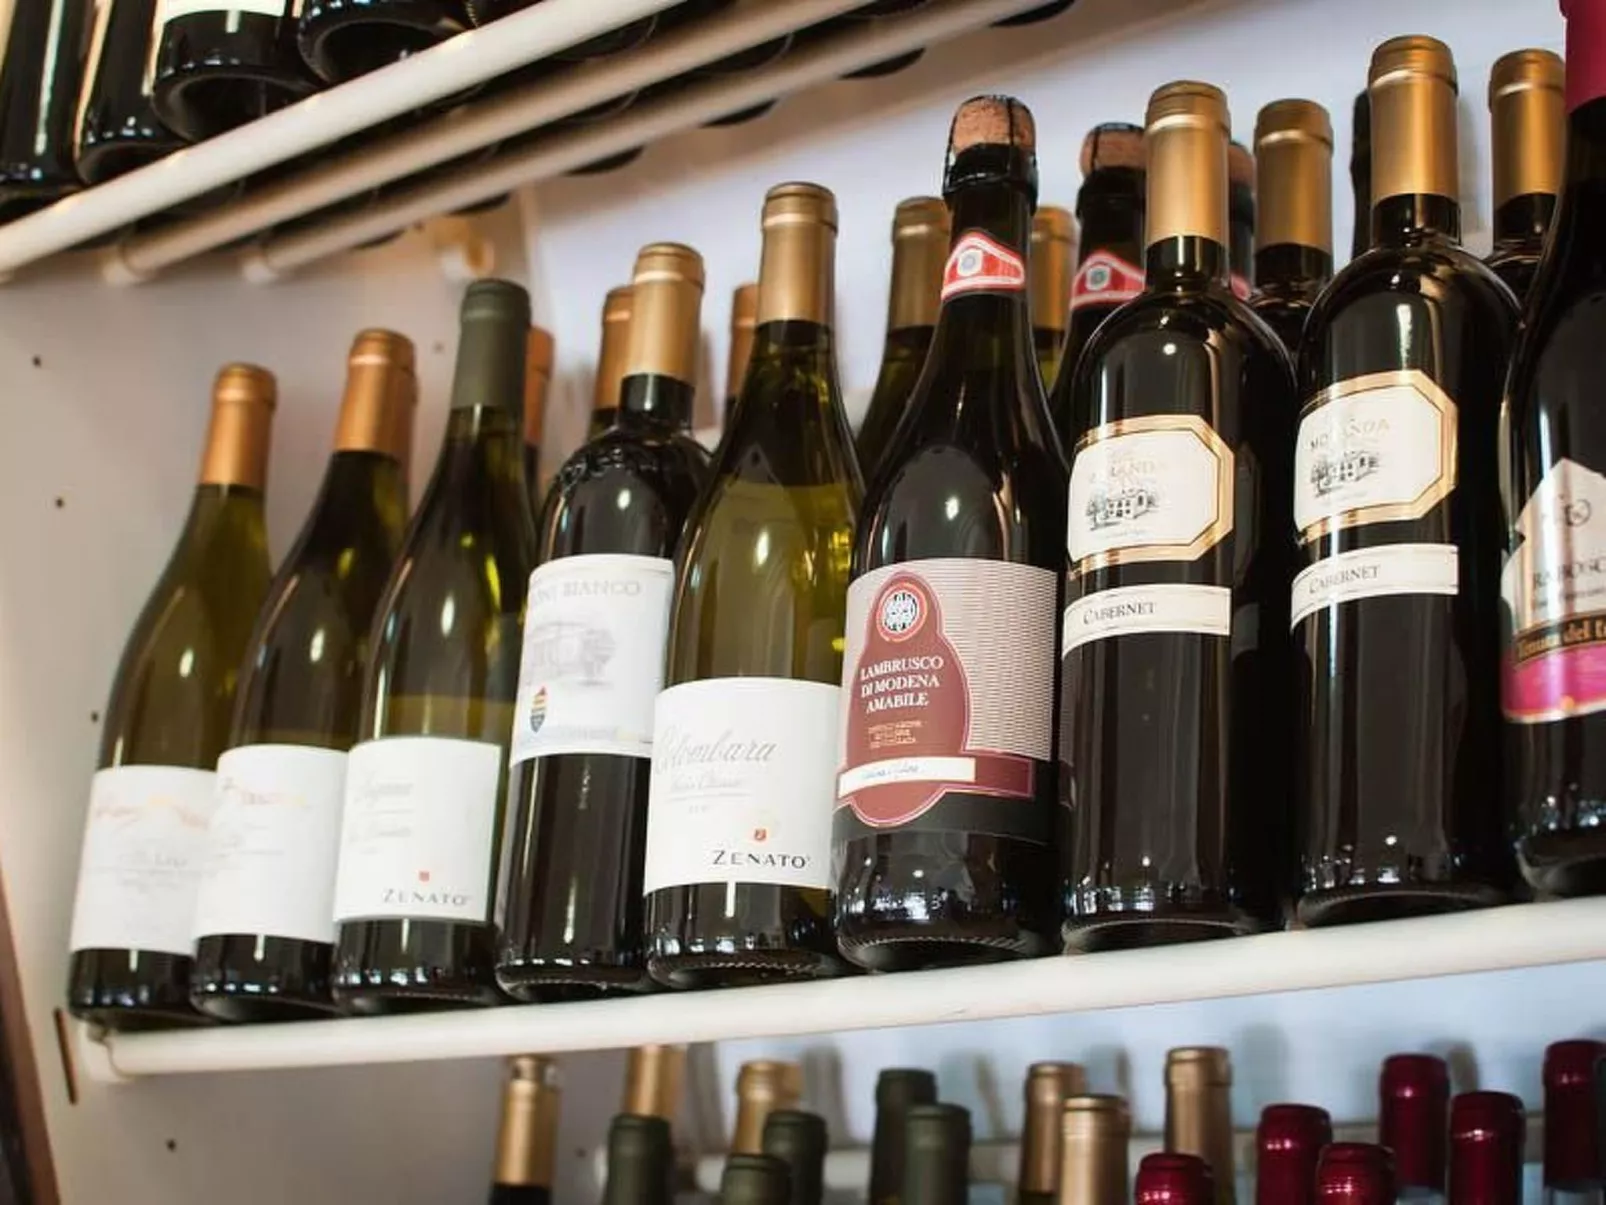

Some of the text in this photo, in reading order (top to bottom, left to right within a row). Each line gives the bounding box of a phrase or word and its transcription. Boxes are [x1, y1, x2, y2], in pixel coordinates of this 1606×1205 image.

[563, 580, 642, 597] BIANCO
[861, 656, 943, 681] LAMBRUSCO
[861, 674, 940, 698] DI MODENA
[866, 692, 929, 714] AMABILE
[712, 848, 807, 870] ZENATO
[382, 887, 468, 907] ZENATO
